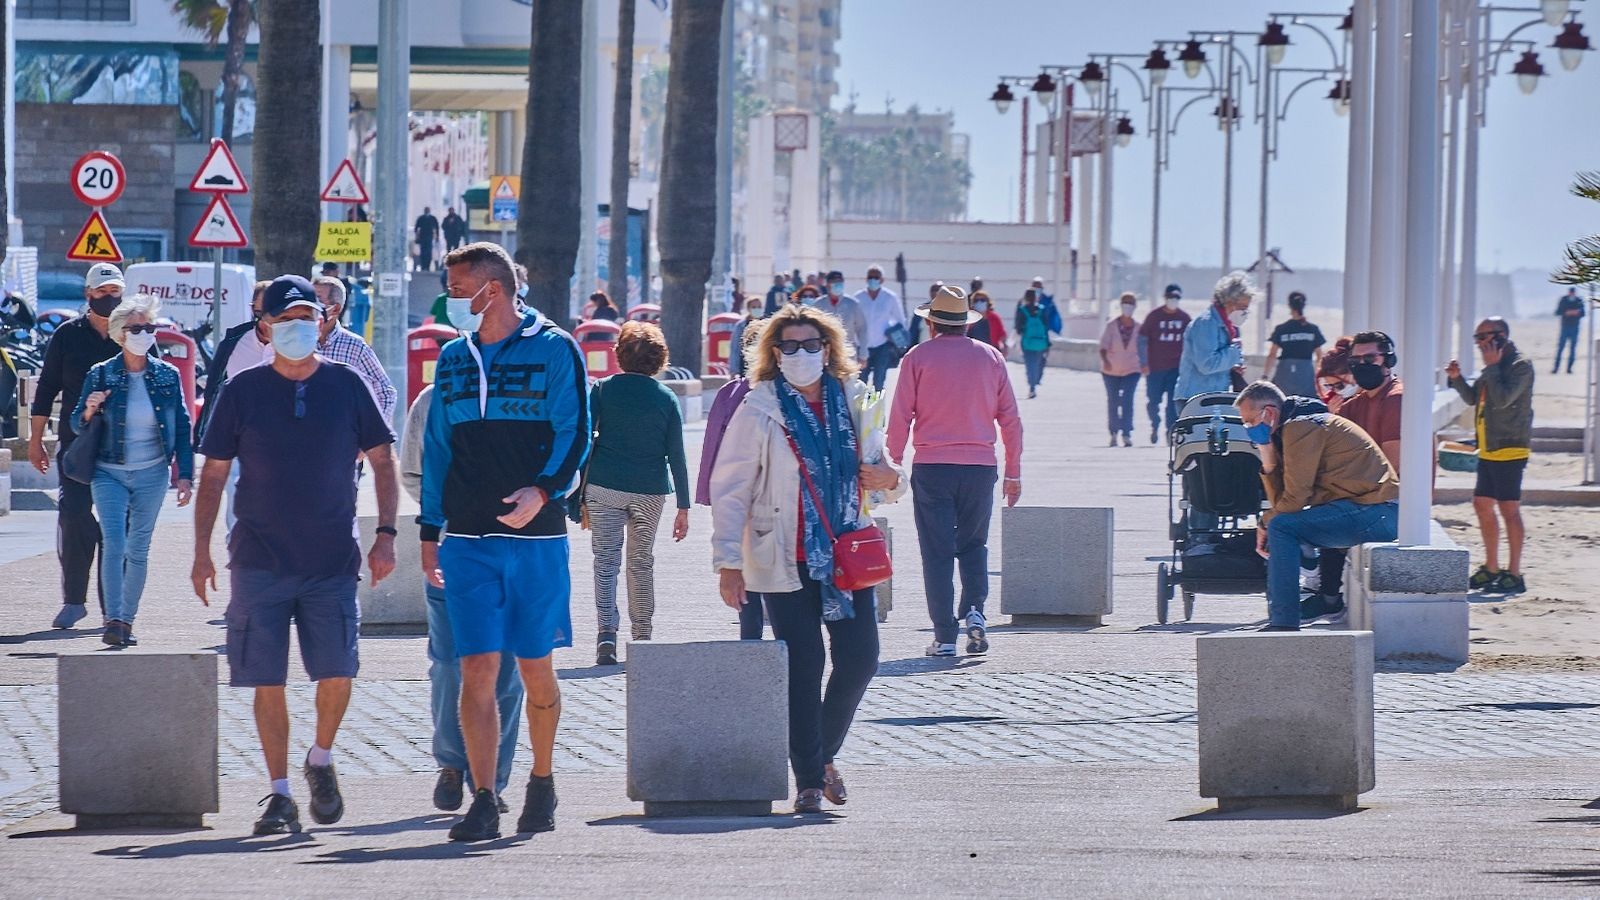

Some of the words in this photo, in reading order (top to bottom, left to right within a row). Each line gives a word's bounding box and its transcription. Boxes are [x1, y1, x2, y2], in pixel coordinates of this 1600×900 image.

[83, 166, 113, 189] 20
[327, 227, 360, 236] SALIDA
[337, 237, 350, 247] DE
[319, 248, 367, 257] CAMIONES
